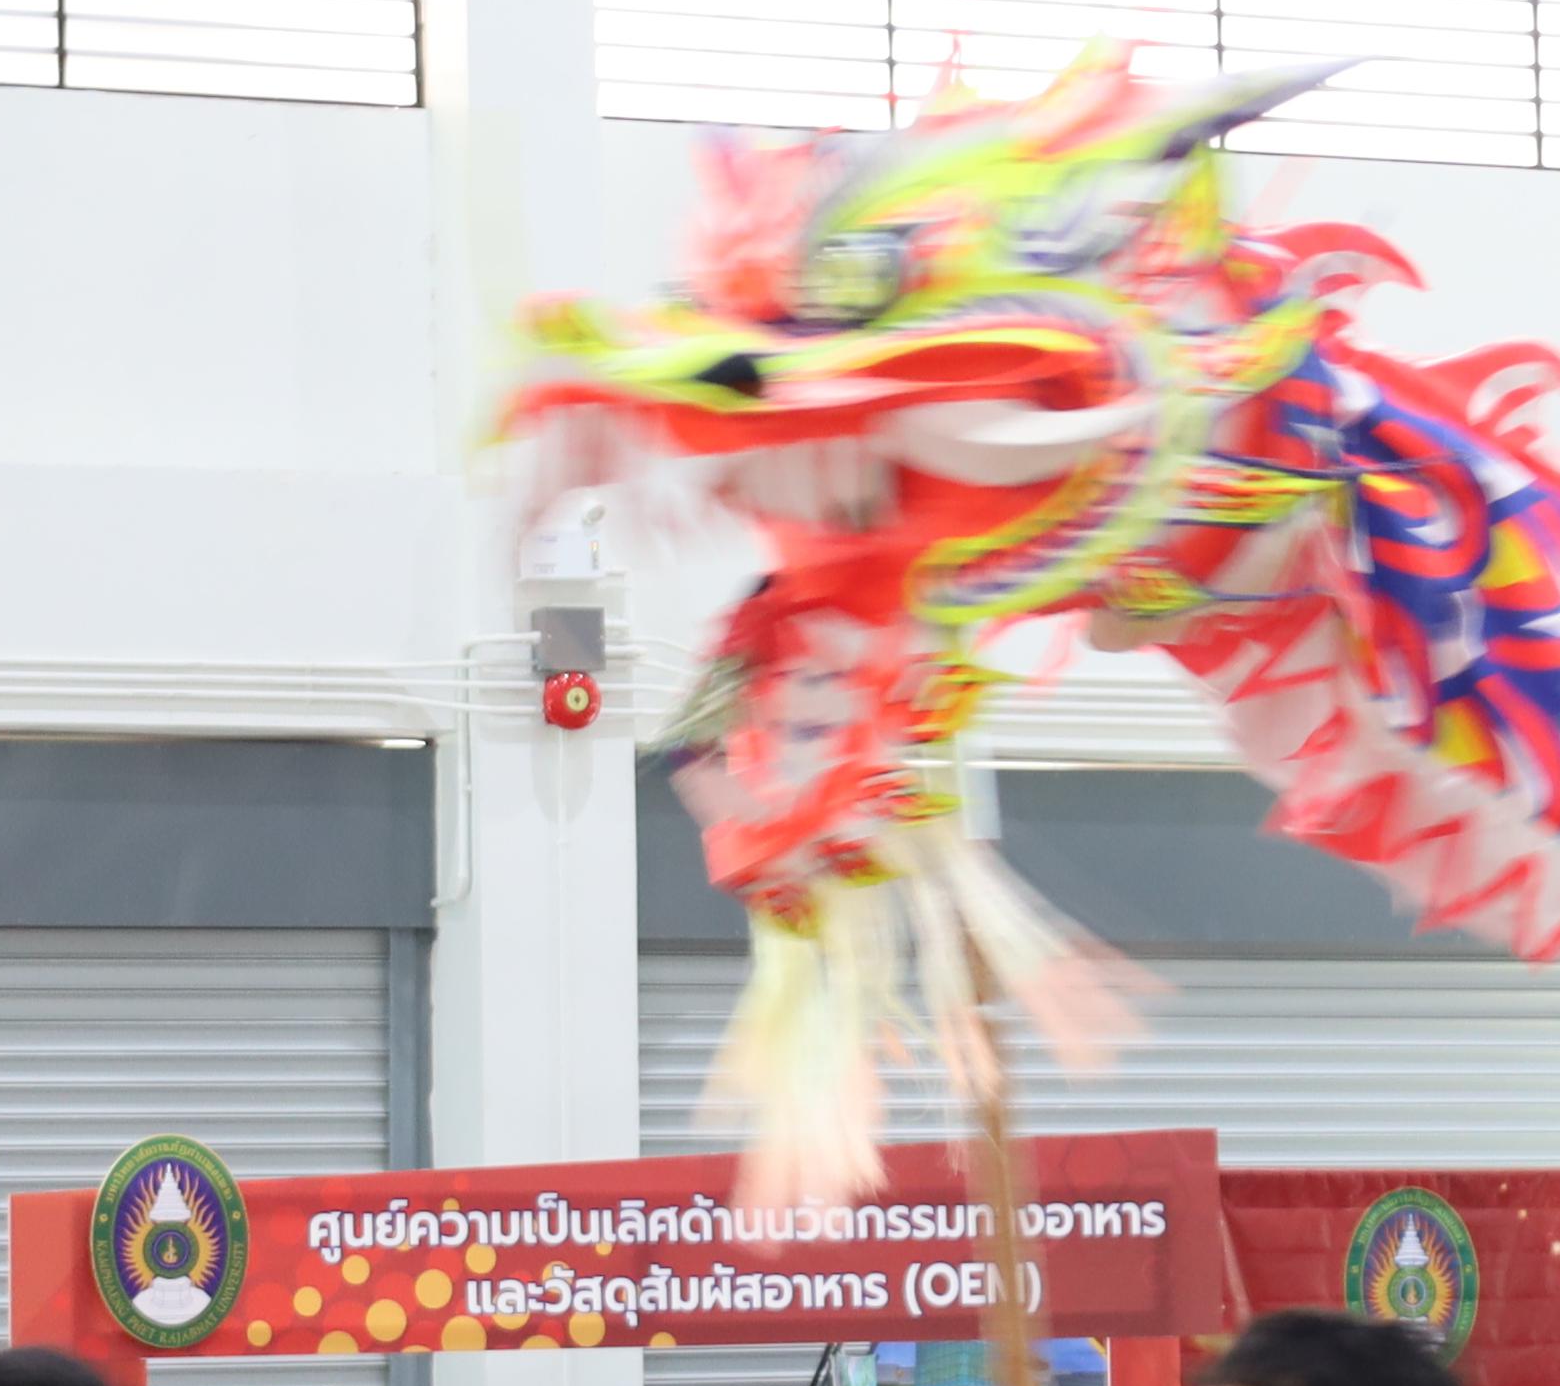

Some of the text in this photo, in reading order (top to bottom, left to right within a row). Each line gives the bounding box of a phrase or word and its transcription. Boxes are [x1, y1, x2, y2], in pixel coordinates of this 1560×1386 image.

[308, 1192, 1166, 1264] ศูนย์ความเป็นเลิศด้านนวัตกรรมทงอาหาร
[466, 1262, 889, 1327] และวัสดุสัมผัสอาหาร
